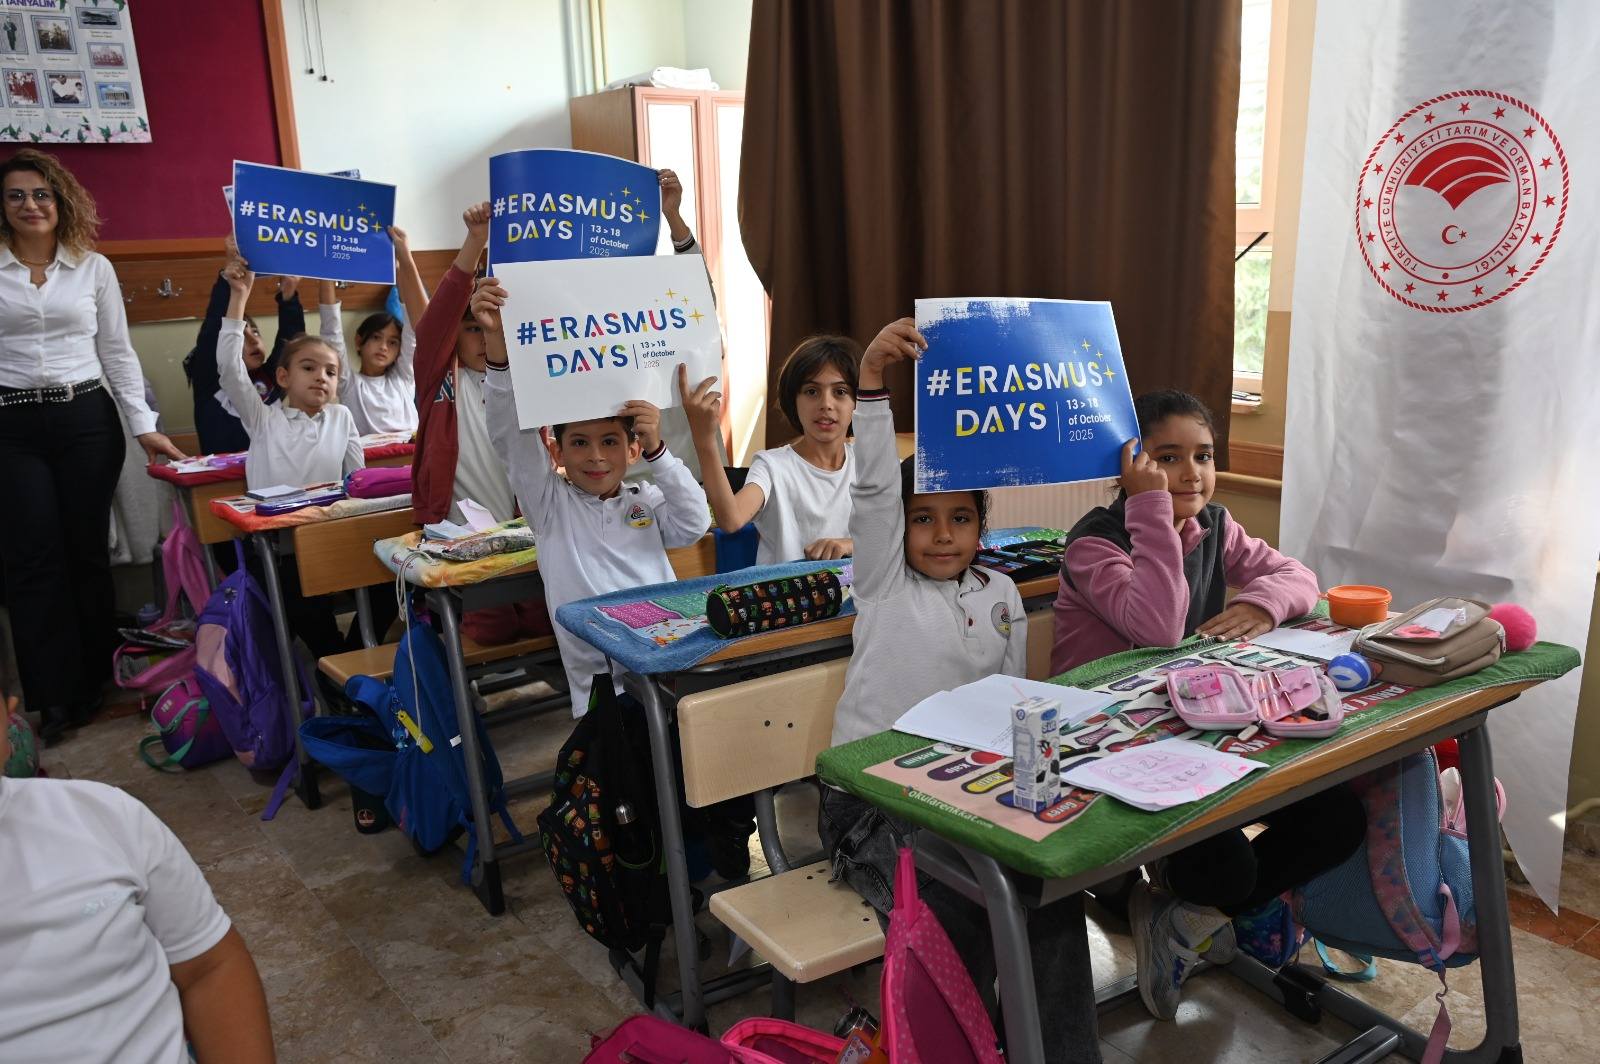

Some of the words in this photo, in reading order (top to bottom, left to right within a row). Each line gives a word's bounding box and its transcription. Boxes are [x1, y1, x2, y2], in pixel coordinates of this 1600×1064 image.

[1446, 125, 1488, 138] TARIM
[1492, 133, 1508, 149] VE
[1383, 131, 1441, 215] CUMHURİYETİ
[1509, 147, 1531, 196] ORMAN
[494, 192, 633, 223] #ERASMUS
[240, 200, 369, 234] #ERASMUS
[257, 225, 318, 248] DAYS
[507, 218, 573, 243] DAYS
[590, 224, 602, 233] 13
[610, 228, 621, 237] 18
[1475, 201, 1531, 273] BAKANLIĞI
[332, 234, 342, 242] 13
[348, 236, 359, 244] 18
[590, 235, 599, 244] of
[600, 237, 630, 250] October
[1383, 221, 1418, 272] TÜRKİYE
[332, 251, 351, 260] 2025
[341, 244, 367, 253] October
[589, 245, 610, 257] 2025
[517, 307, 687, 345] #ERASMUS
[640, 341, 650, 349] 13
[656, 339, 666, 347] 18
[642, 350, 649, 358] of
[650, 348, 675, 358] October
[547, 344, 628, 378] DAYS
[643, 359, 660, 369] 2025
[926, 361, 1103, 396] #ERASMUS
[1066, 399, 1079, 410] 13
[1087, 398, 1099, 408] 18
[956, 402, 1047, 437] DAYS
[1068, 415, 1079, 426] of
[1079, 414, 1112, 425] October
[1069, 430, 1094, 442] 2025
